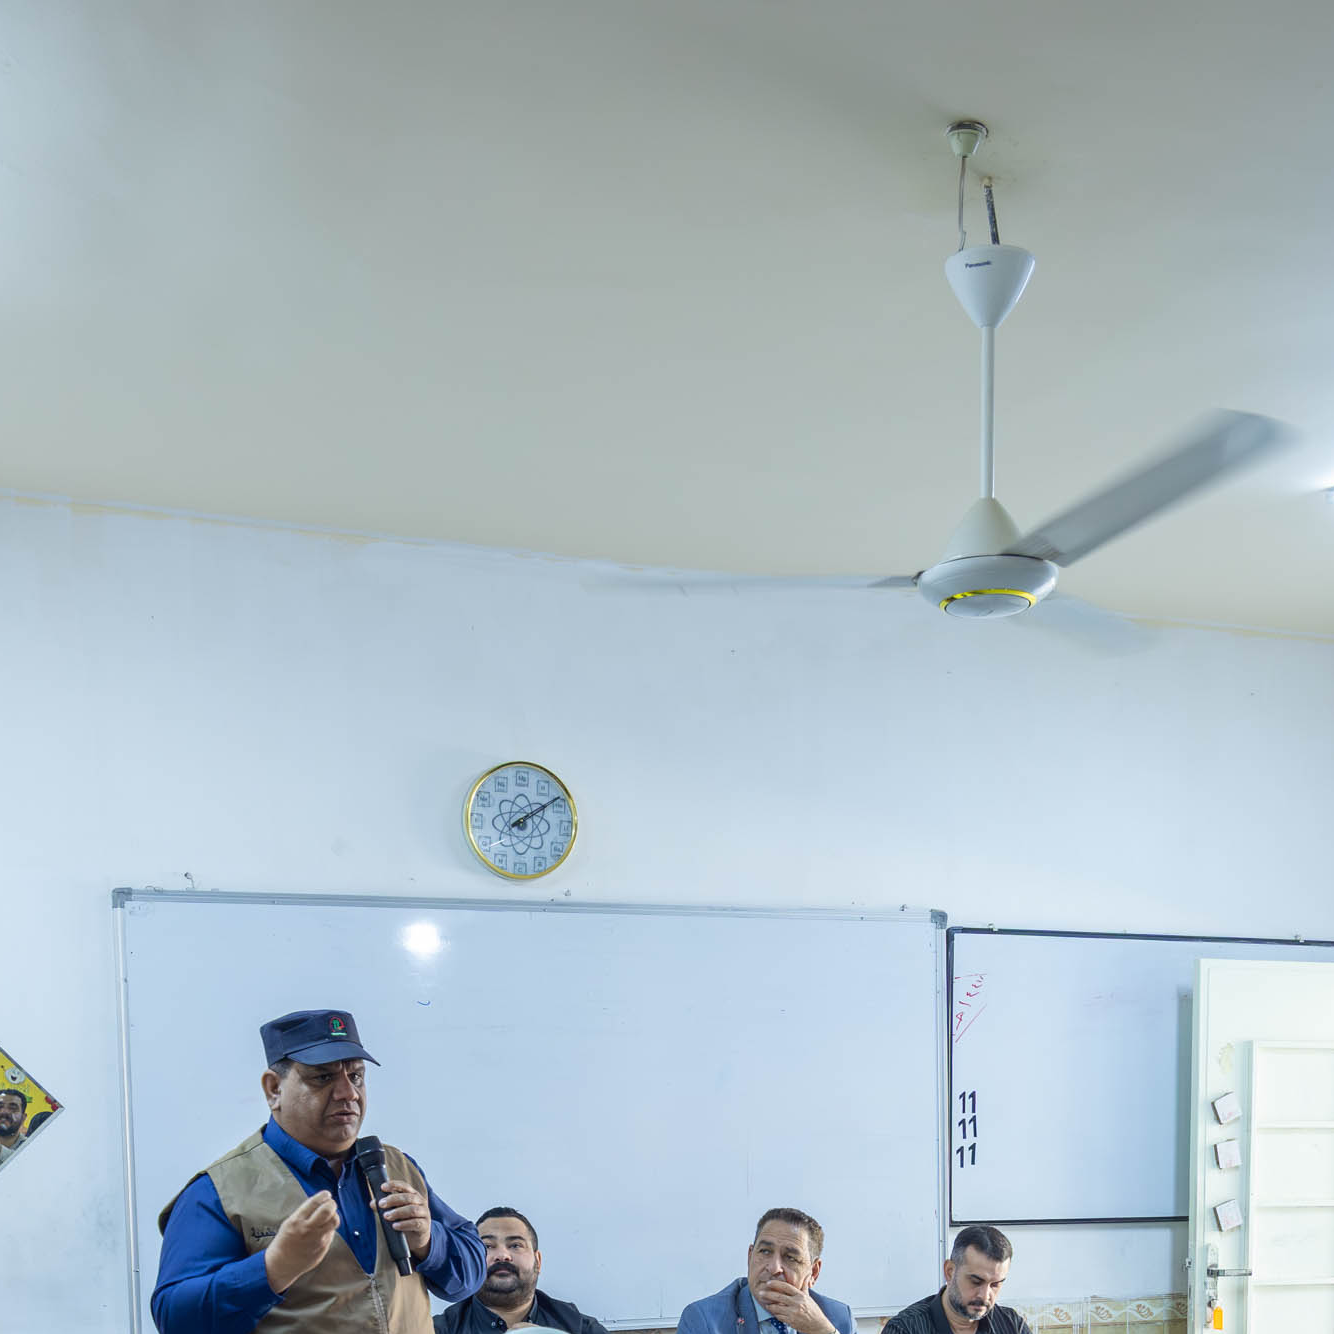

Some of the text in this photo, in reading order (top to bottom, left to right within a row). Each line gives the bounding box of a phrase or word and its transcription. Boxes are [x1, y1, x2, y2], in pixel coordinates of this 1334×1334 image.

[958, 1090, 977, 1114] 11
[958, 1115, 978, 1139] 11
[956, 1143, 977, 1169] 11
